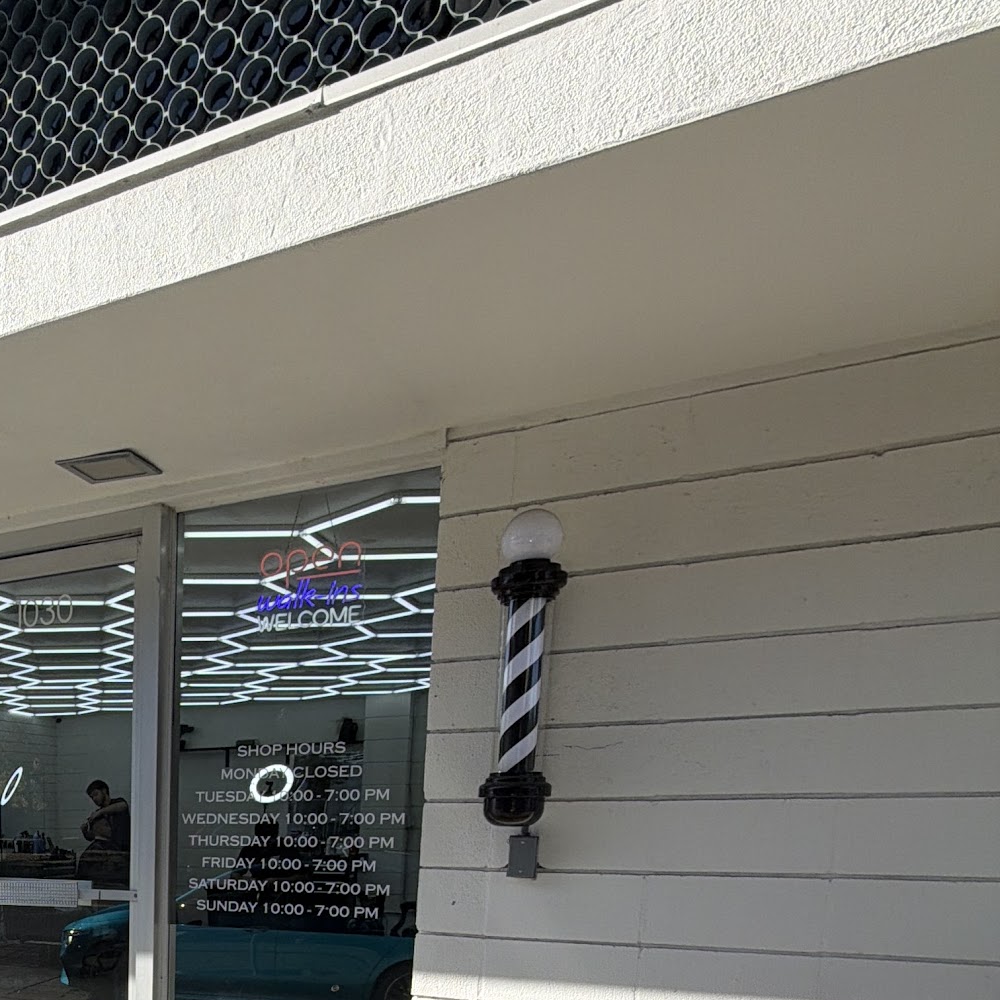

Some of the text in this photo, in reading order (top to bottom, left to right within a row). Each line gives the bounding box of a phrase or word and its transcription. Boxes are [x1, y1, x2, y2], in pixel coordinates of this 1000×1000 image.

[261, 541, 362, 589] open
[17, 594, 73, 627] 1030
[257, 605, 362, 633] WELCOME
[237, 741, 347, 757] SHOP HOURS
[293, 765, 363, 778] CLOSED
[324, 789, 360, 801] 7:00
[365, 788, 390, 801] PM
[182, 812, 280, 825] WEDNESDAY
[285, 812, 328, 825] 10:00
[339, 812, 375, 825] 7:00
[380, 812, 406, 825] PM
[188, 834, 271, 848] THURSDAY
[276, 835, 318, 848] 10:00
[328, 836, 365, 849] 7:00
[369, 836, 394, 849] PM
[201, 856, 255, 869] FRIDAY
[260, 858, 302, 871] 10:00
[312, 859, 347, 872] 7:00
[351, 860, 376, 872] PM
[188, 877, 268, 892] SATURDAY
[273, 880, 315, 893] 10:00
[325, 882, 361, 895] 7:00
[365, 883, 390, 896] PM
[196, 899, 258, 913] SUNDAY
[263, 902, 304, 915] 10:00
[354, 906, 379, 919] PM
